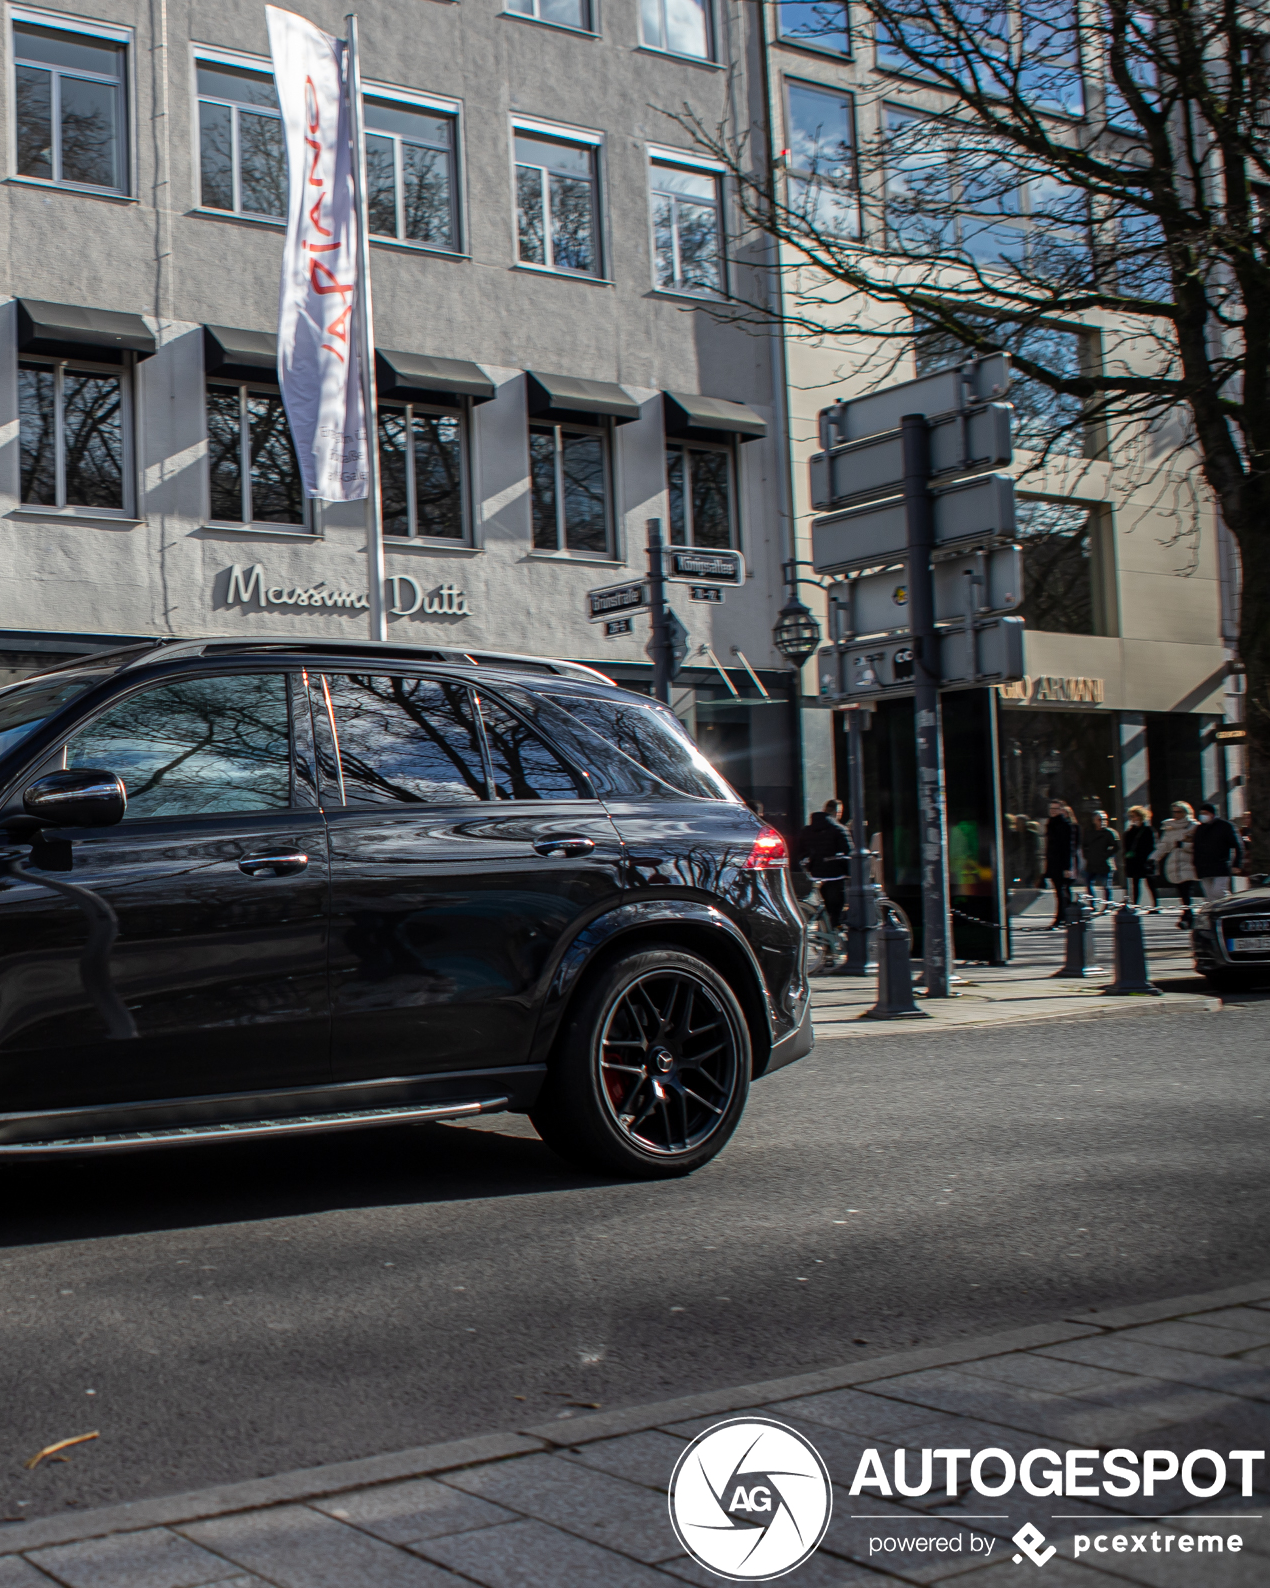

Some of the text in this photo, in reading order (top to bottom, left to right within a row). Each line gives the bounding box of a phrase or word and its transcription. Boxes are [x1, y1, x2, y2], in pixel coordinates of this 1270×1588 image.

[227, 564, 474, 616] Massim Dutti
[1037, 675, 1104, 703] ARMANI
